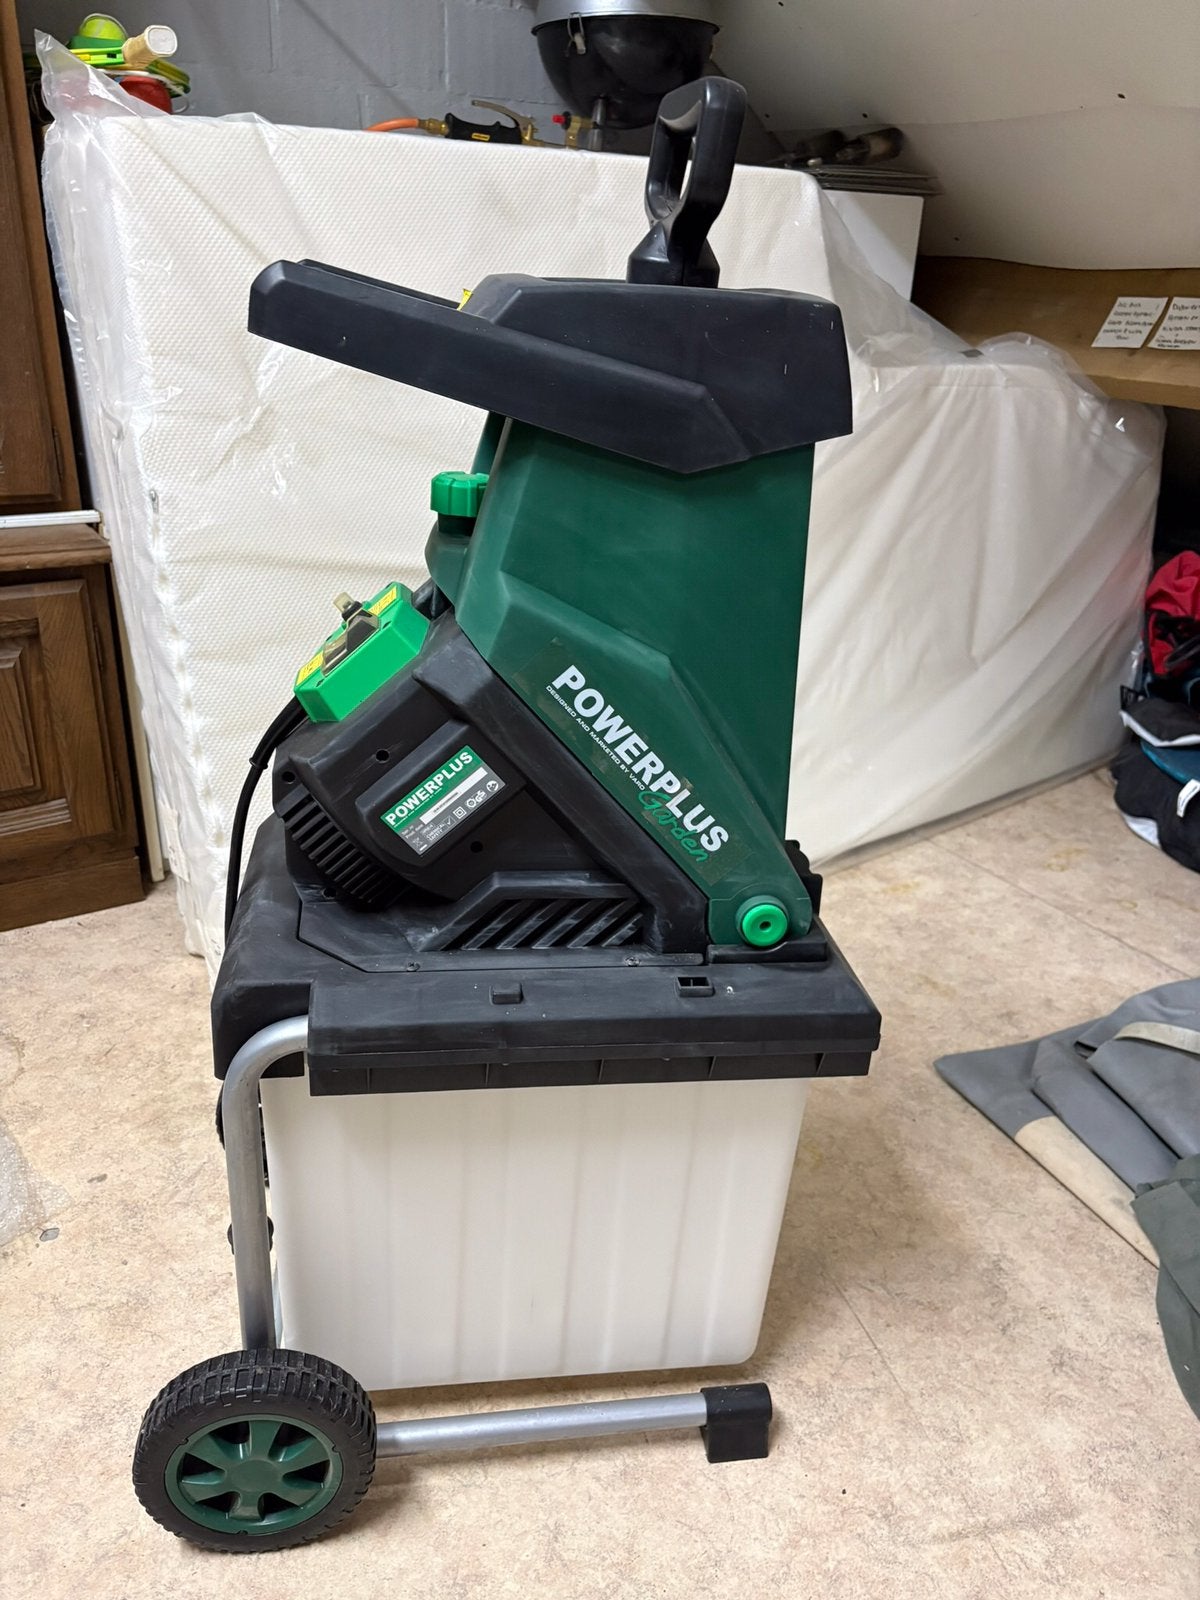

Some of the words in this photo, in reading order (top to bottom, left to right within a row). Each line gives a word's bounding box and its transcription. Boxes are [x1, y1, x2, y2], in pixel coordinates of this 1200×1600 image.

[546, 685, 577, 717] DESIGNED
[576, 718, 590, 732] AND
[589, 732, 621, 765] MARKETED
[620, 764, 630, 774] BY
[629, 774, 646, 791] VARO
[552, 665, 729, 852] POWERPLUS
[385, 752, 473, 826] POWERPLUS
[638, 790, 709, 863] Garden
